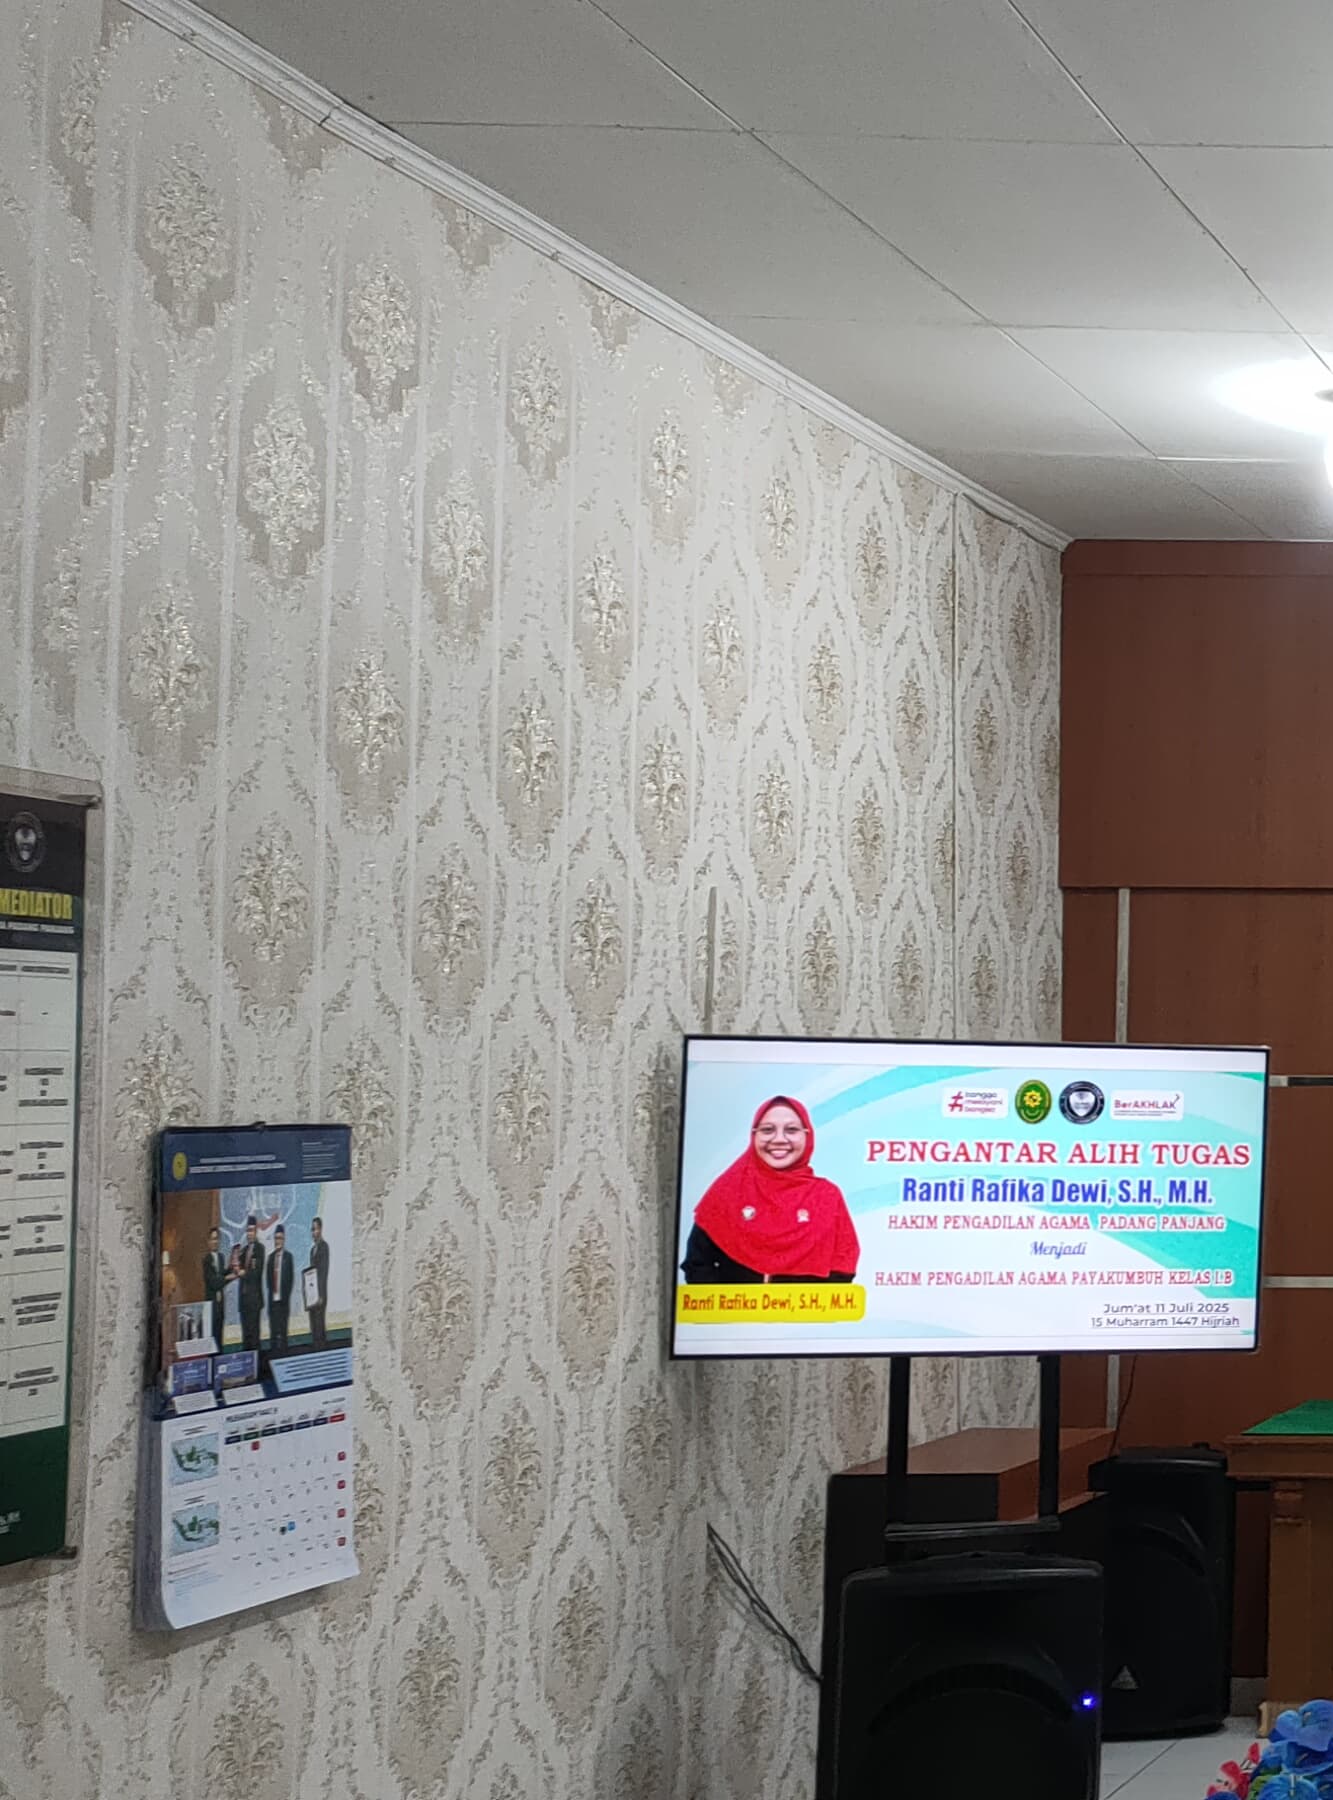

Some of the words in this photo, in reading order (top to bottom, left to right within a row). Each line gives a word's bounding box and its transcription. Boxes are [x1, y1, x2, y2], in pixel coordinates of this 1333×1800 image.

[1114, 1099, 1176, 1109] BerAKHLAK
[867, 1141, 1057, 1163] PENGANTAR
[1068, 1143, 1139, 1164] ALIH
[1152, 1144, 1250, 1165] TUGAS
[903, 1178, 965, 1202] Ranti
[971, 1178, 1044, 1202] Rafika
[1052, 1179, 1111, 1204] Dewi,
[1118, 1180, 1162, 1204] S.H.,
[1168, 1180, 1213, 1203] M.H.
[888, 1215, 938, 1229] HAKIM
[943, 1215, 1035, 1229] PENGADILAN
[1039, 1215, 1090, 1230] AGAMA
[1100, 1216, 1156, 1230] PADANG
[1161, 1216, 1224, 1230] PANJANG
[1030, 1241, 1087, 1259] Menjadi
[875, 1271, 921, 1286] HAKIM
[927, 1271, 1014, 1286] PENGADILAN
[1018, 1271, 1067, 1286] AGAMA
[1072, 1271, 1163, 1285] PAYAKUMBUH
[1168, 1271, 1211, 1285] KELAS
[682, 1294, 714, 1311] Ranti
[719, 1294, 757, 1310] Rafika
[762, 1293, 795, 1312] Dewi,
[829, 1293, 857, 1309] M.H.
[1104, 1303, 1150, 1314] Jum'at
[1156, 1303, 1165, 1314] 11
[1169, 1303, 1194, 1314] Juli
[1197, 1303, 1230, 1313] 2025
[1091, 1317, 1103, 1327] 15
[1106, 1317, 1168, 1327] Muharram
[1172, 1317, 1198, 1327] 1447
[1201, 1317, 1240, 1329] Hijriah
